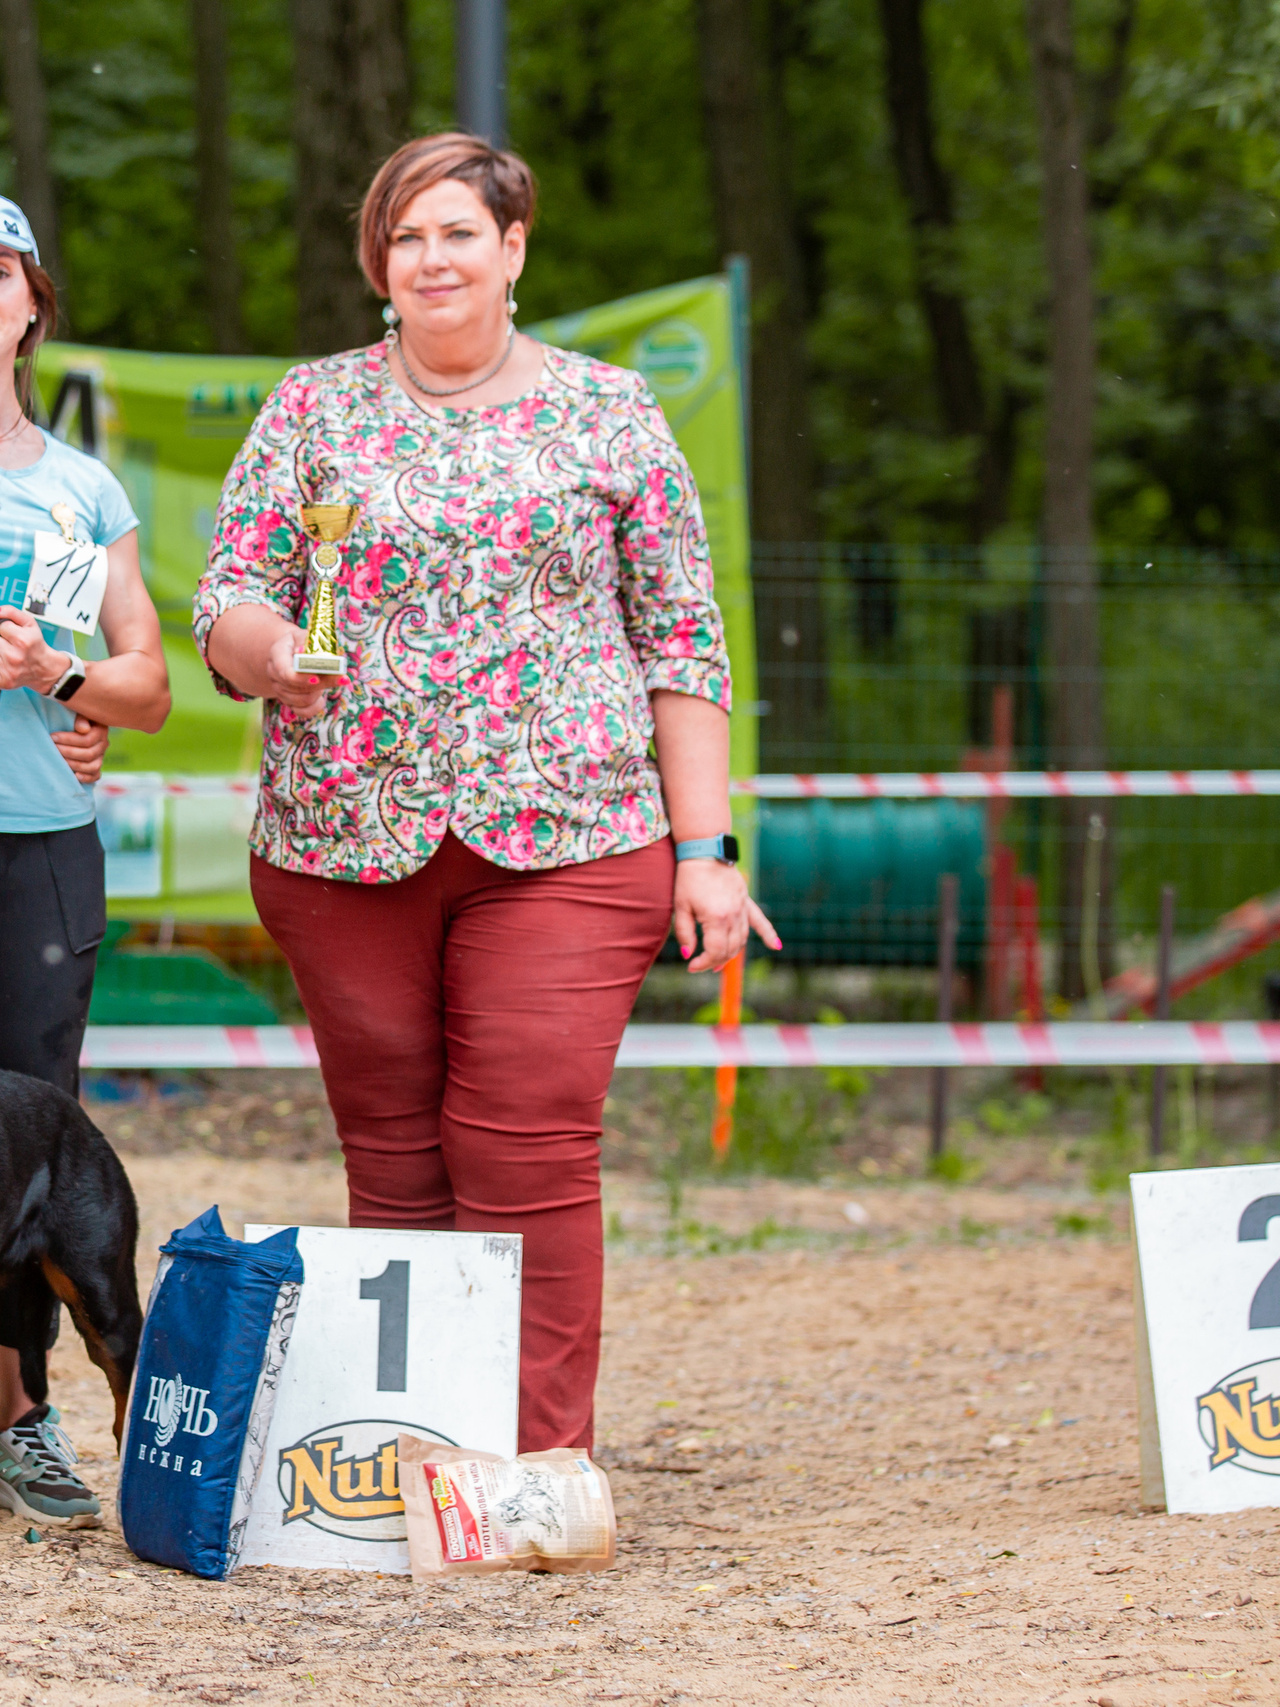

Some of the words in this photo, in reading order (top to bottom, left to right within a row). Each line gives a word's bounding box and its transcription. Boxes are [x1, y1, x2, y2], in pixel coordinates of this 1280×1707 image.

[46, 548, 97, 608] 11
[359, 1260, 410, 1392] 1
[143, 1373, 219, 1437] НОЧЬ
[1197, 1377, 1280, 1471] Nu
[280, 1437, 403, 1525] Nut
[444, 1510, 462, 1558] ЗООМЕНЮ
[474, 1486, 492, 1555] ПРОТЕИНОВЫЕ
